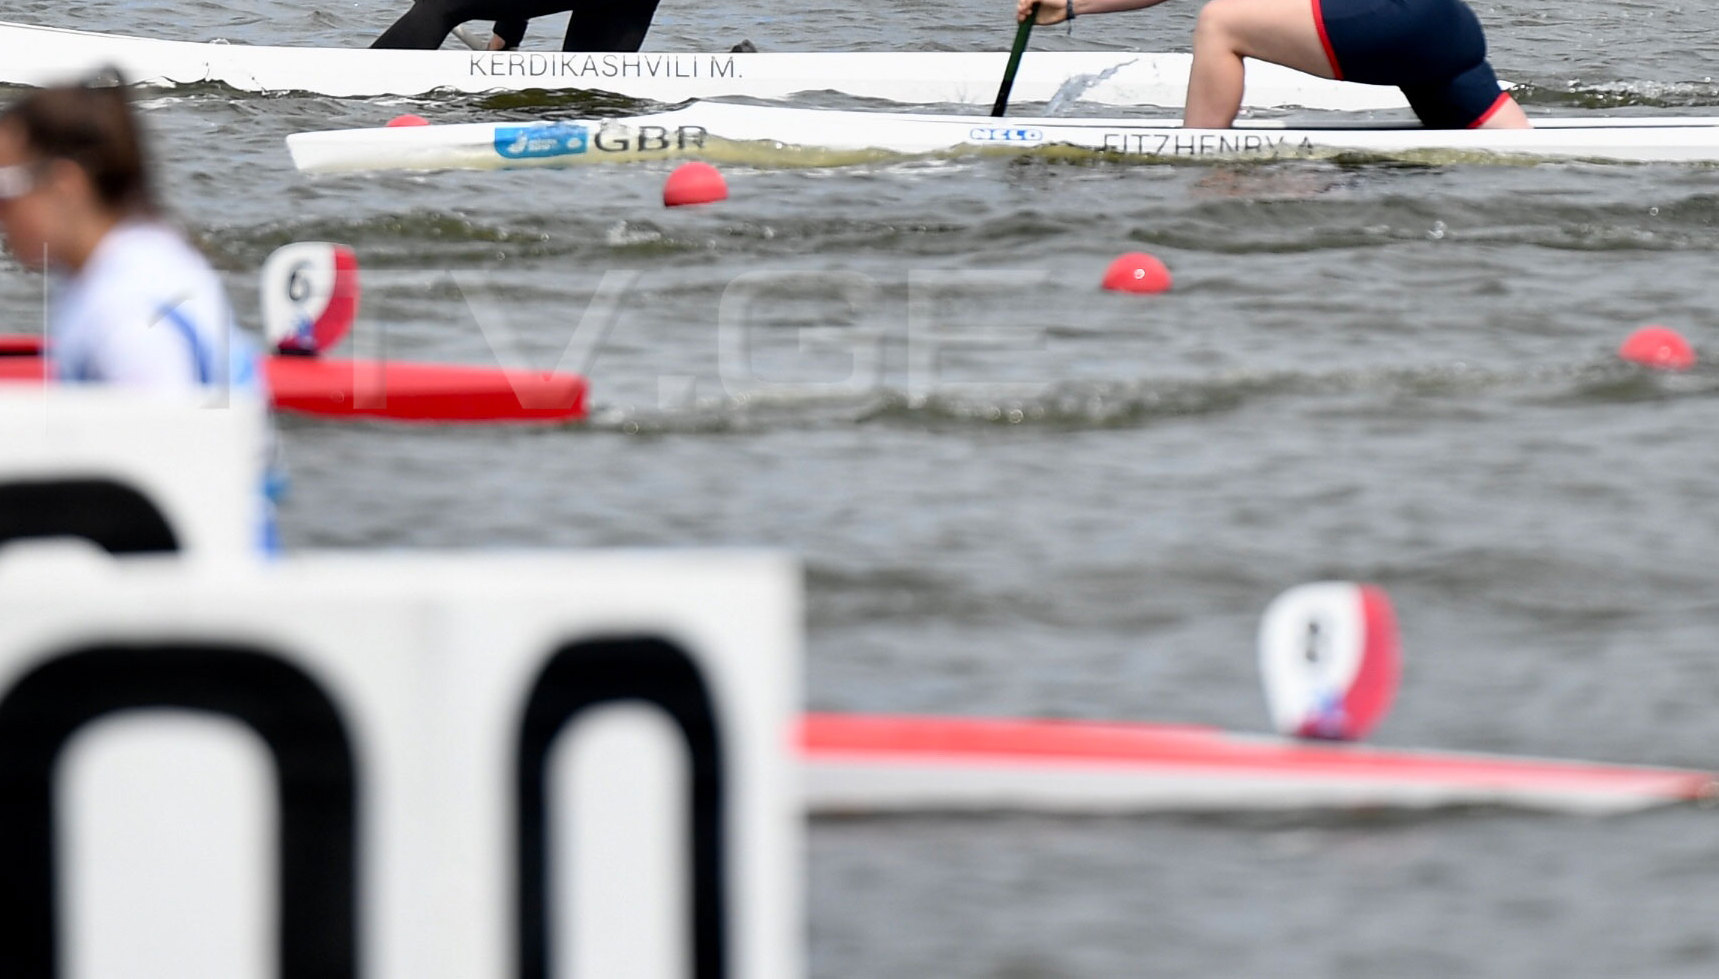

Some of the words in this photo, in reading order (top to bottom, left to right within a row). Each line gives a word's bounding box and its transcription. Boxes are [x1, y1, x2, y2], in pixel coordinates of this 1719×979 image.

[469, 54, 698, 78] KERDIKASHVILI
[710, 56, 743, 78] M.
[593, 124, 708, 153] GBR
[970, 128, 1043, 141] NELO
[287, 259, 314, 302] 6
